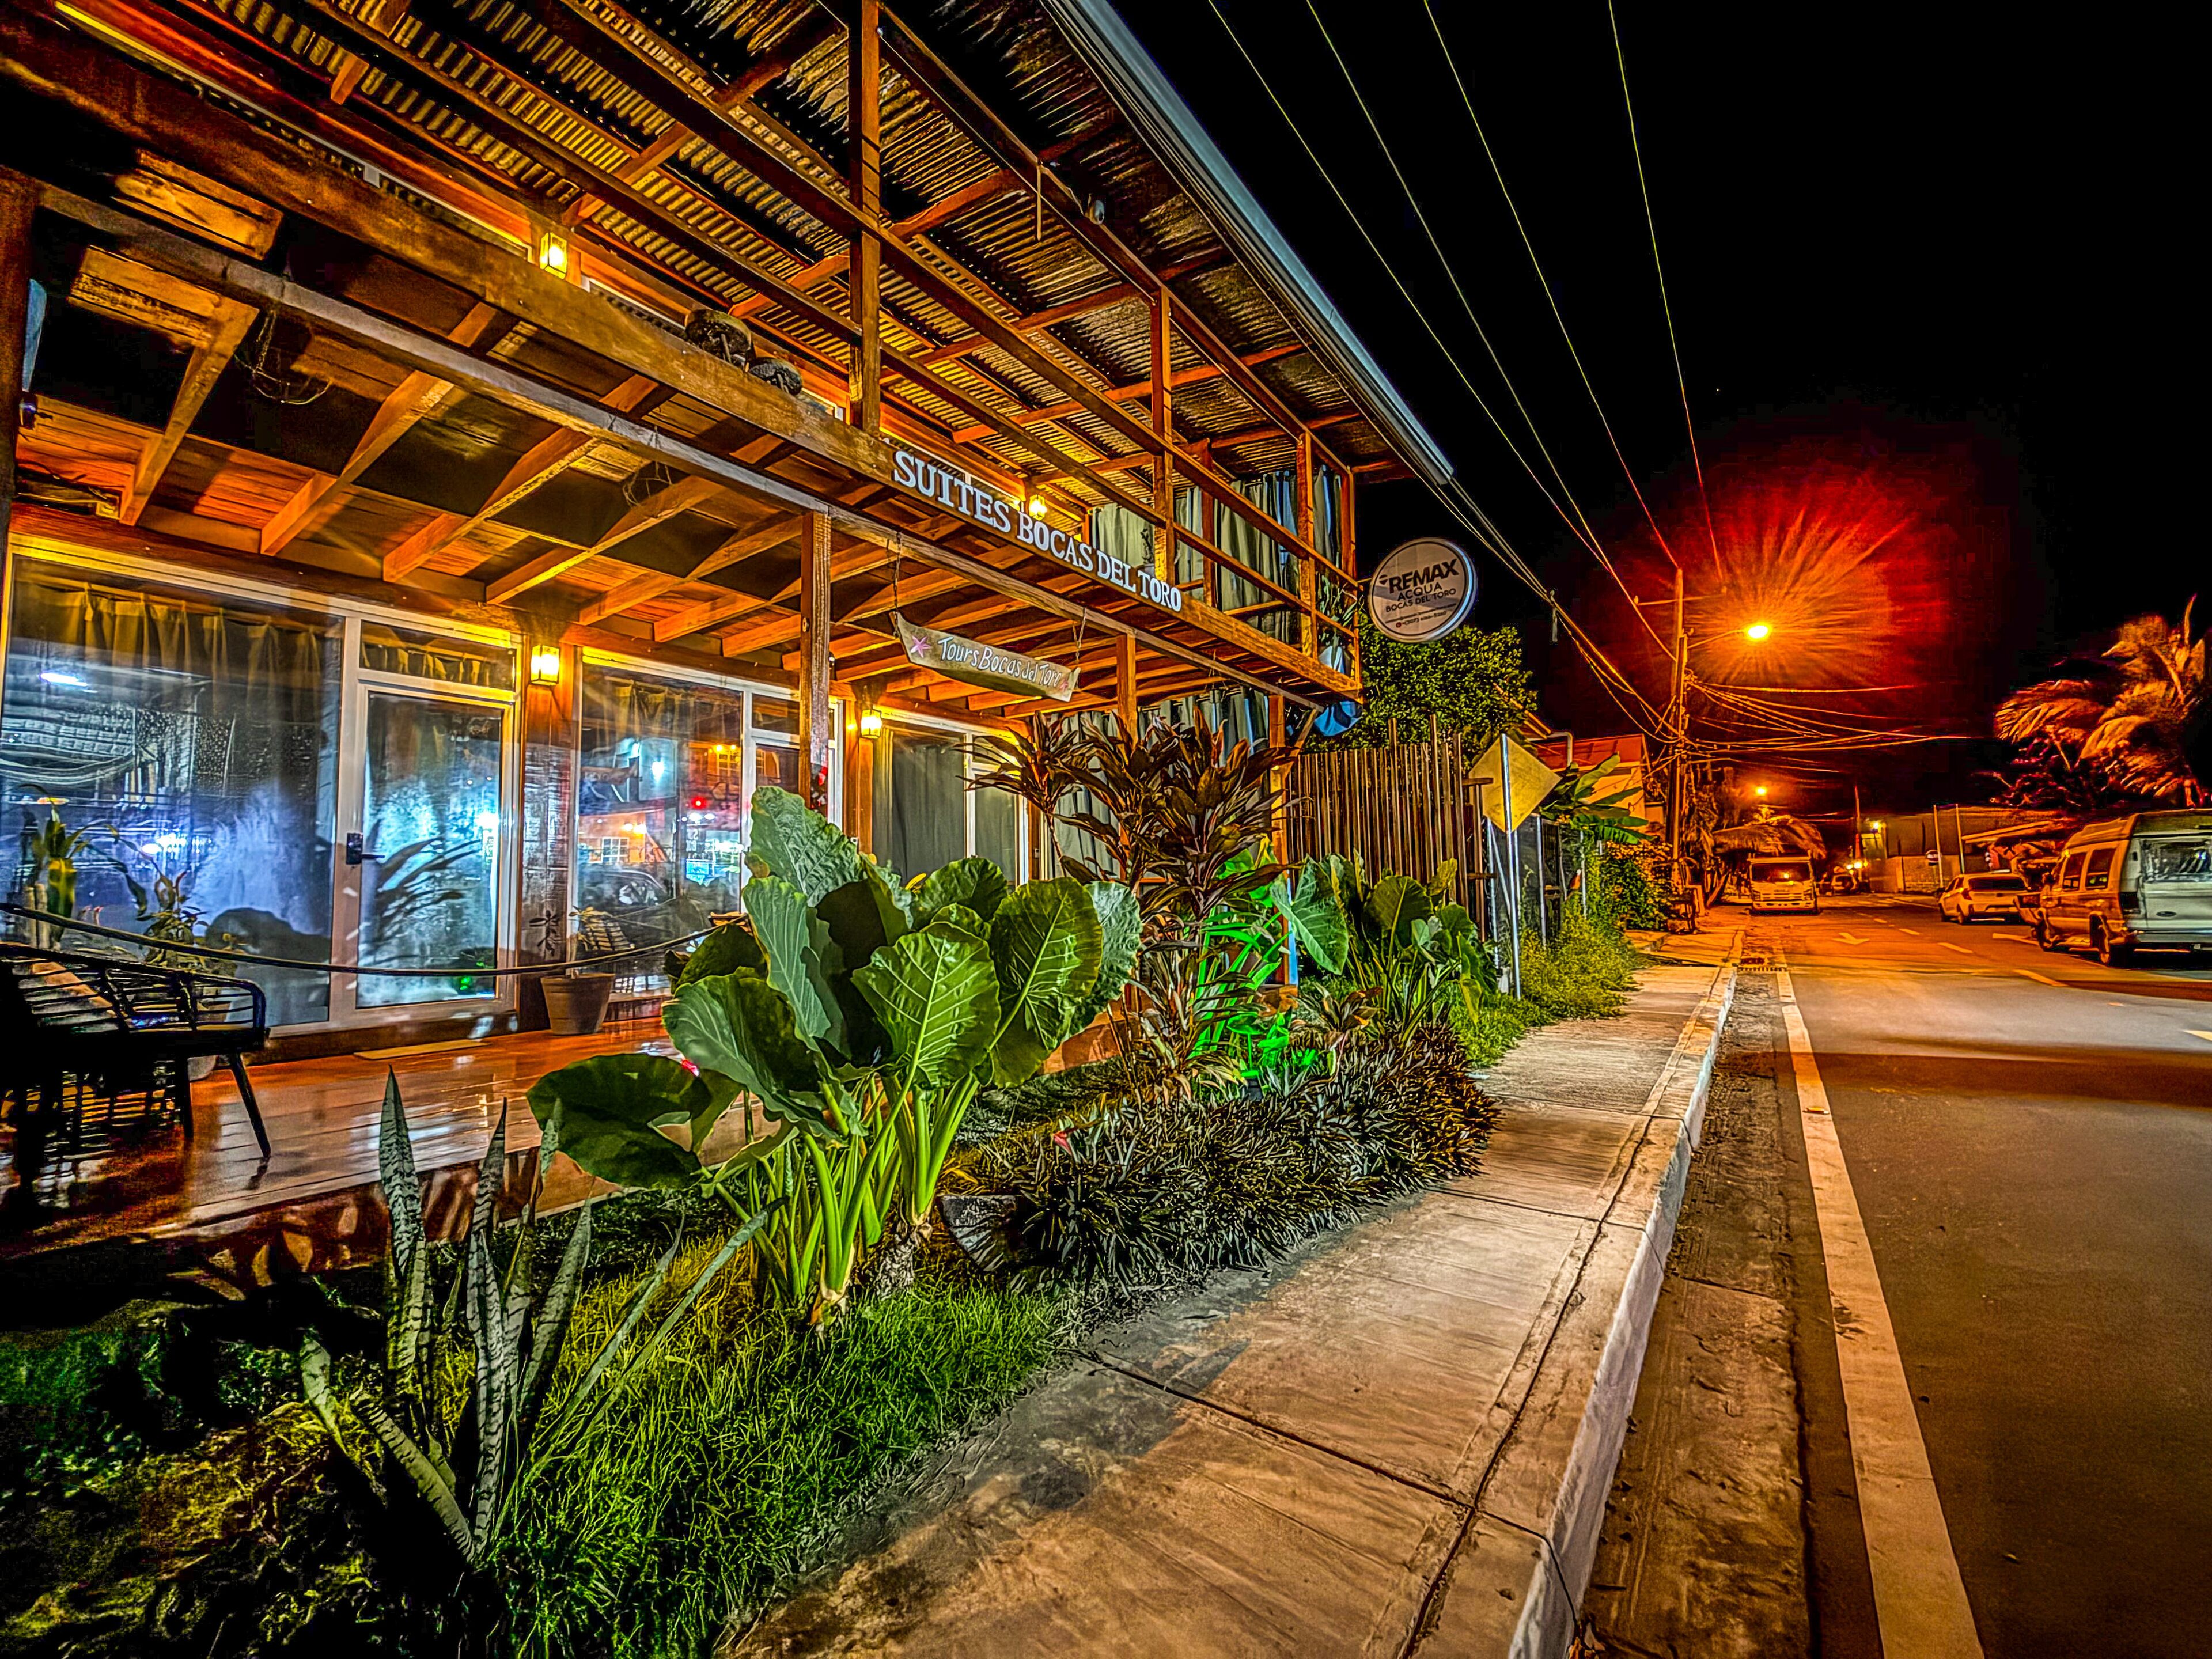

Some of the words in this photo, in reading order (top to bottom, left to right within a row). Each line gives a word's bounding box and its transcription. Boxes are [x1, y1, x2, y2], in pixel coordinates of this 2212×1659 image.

[894, 450, 1012, 533] SUITES
[1017, 510, 1094, 574] BOCAS
[1096, 548, 1137, 593] DEL
[1138, 569, 1181, 612] TORO
[1388, 558, 1460, 594] REMAX
[1397, 581, 1442, 601] ACQUA
[1385, 599, 1414, 612] BOCAS
[1415, 596, 1431, 605] DEL
[1431, 588, 1456, 600] TORO
[937, 636, 979, 667] Tours
[976, 646, 1022, 677] Bocas
[1021, 660, 1038, 683] del
